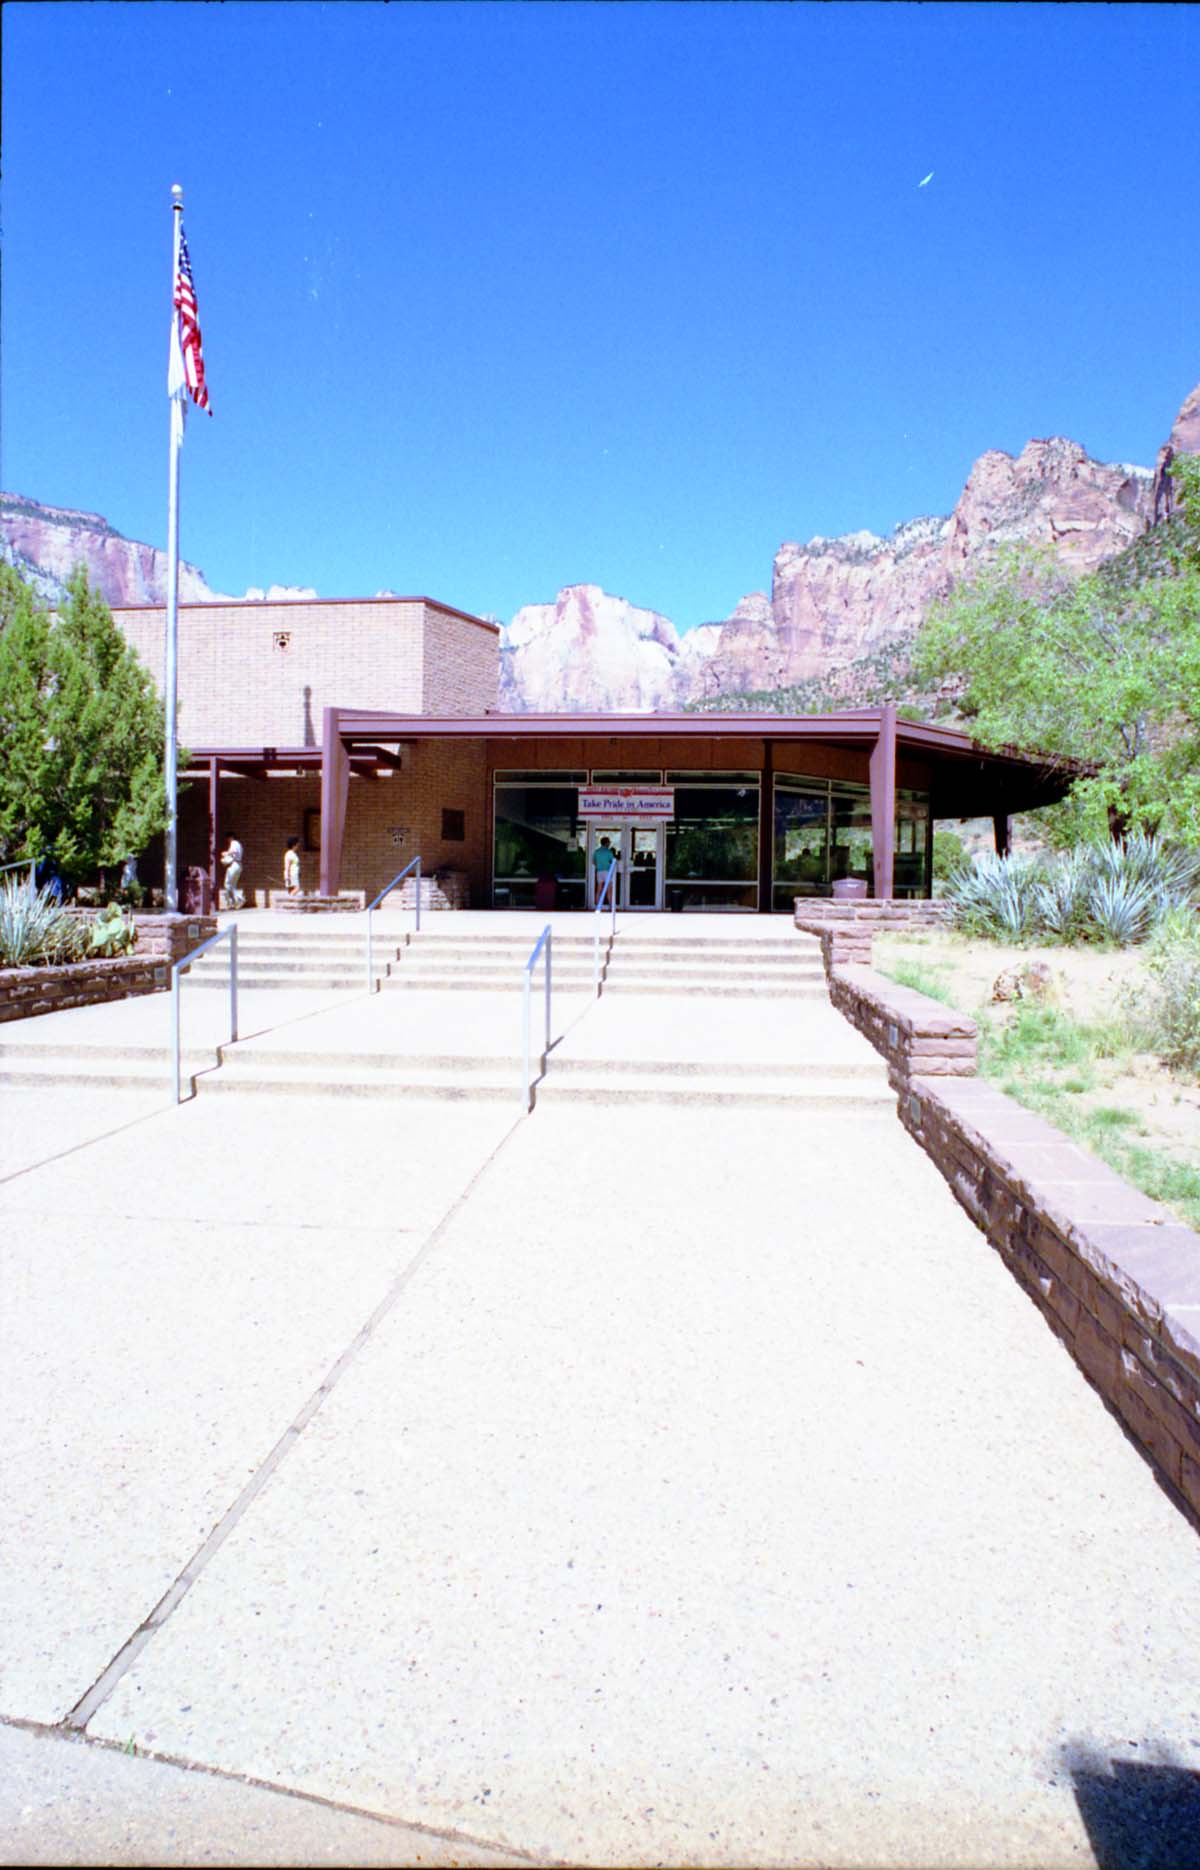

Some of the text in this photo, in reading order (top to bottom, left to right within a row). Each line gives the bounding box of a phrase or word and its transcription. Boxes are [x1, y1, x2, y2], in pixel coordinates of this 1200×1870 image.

[583, 799, 671, 808] Take Pride in America
